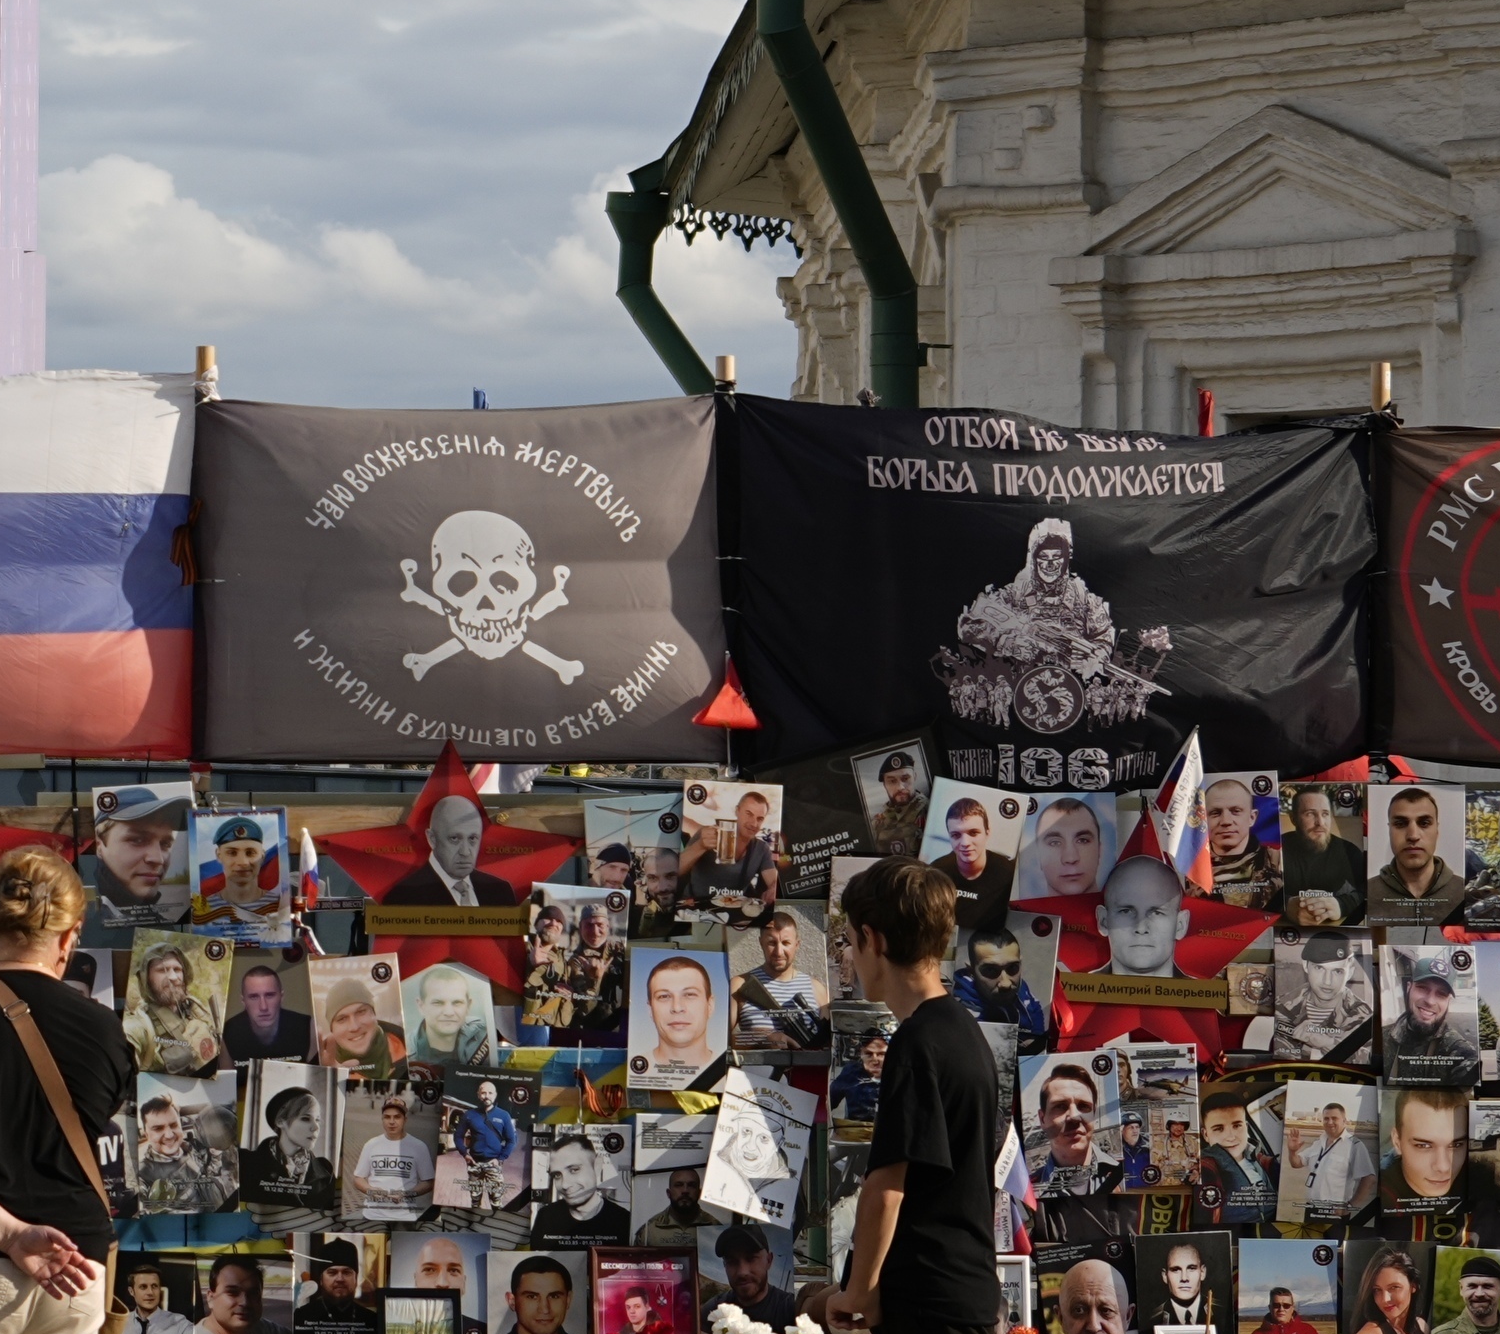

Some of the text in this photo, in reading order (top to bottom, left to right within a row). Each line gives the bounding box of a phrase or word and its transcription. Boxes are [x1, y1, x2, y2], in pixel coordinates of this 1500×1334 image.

[923, 415, 1069, 452] ОТБОЯ НЕ
[866, 455, 1225, 505] БОРЬБА ПРОДОЛЖАЕТСЯ!
[1425, 473, 1496, 554] PMC
[308, 646, 399, 725] ЖИЗНИ
[1441, 640, 1500, 716] КРОВЬ
[787, 838, 860, 866] "Левиафан"
[791, 830, 850, 854] Кузнецов
[799, 860, 831, 877] Дмит
[708, 885, 745, 898] Руфим
[954, 888, 980, 901] рзик
[1298, 889, 1335, 899] Полигон
[370, 915, 529, 927] Пригожин Евгений Викторович
[1060, 980, 1227, 1000] Уткин Дмитрий Валерьевич
[1306, 1025, 1342, 1036] Жаргон
[370, 1156, 413, 1172] adidas
